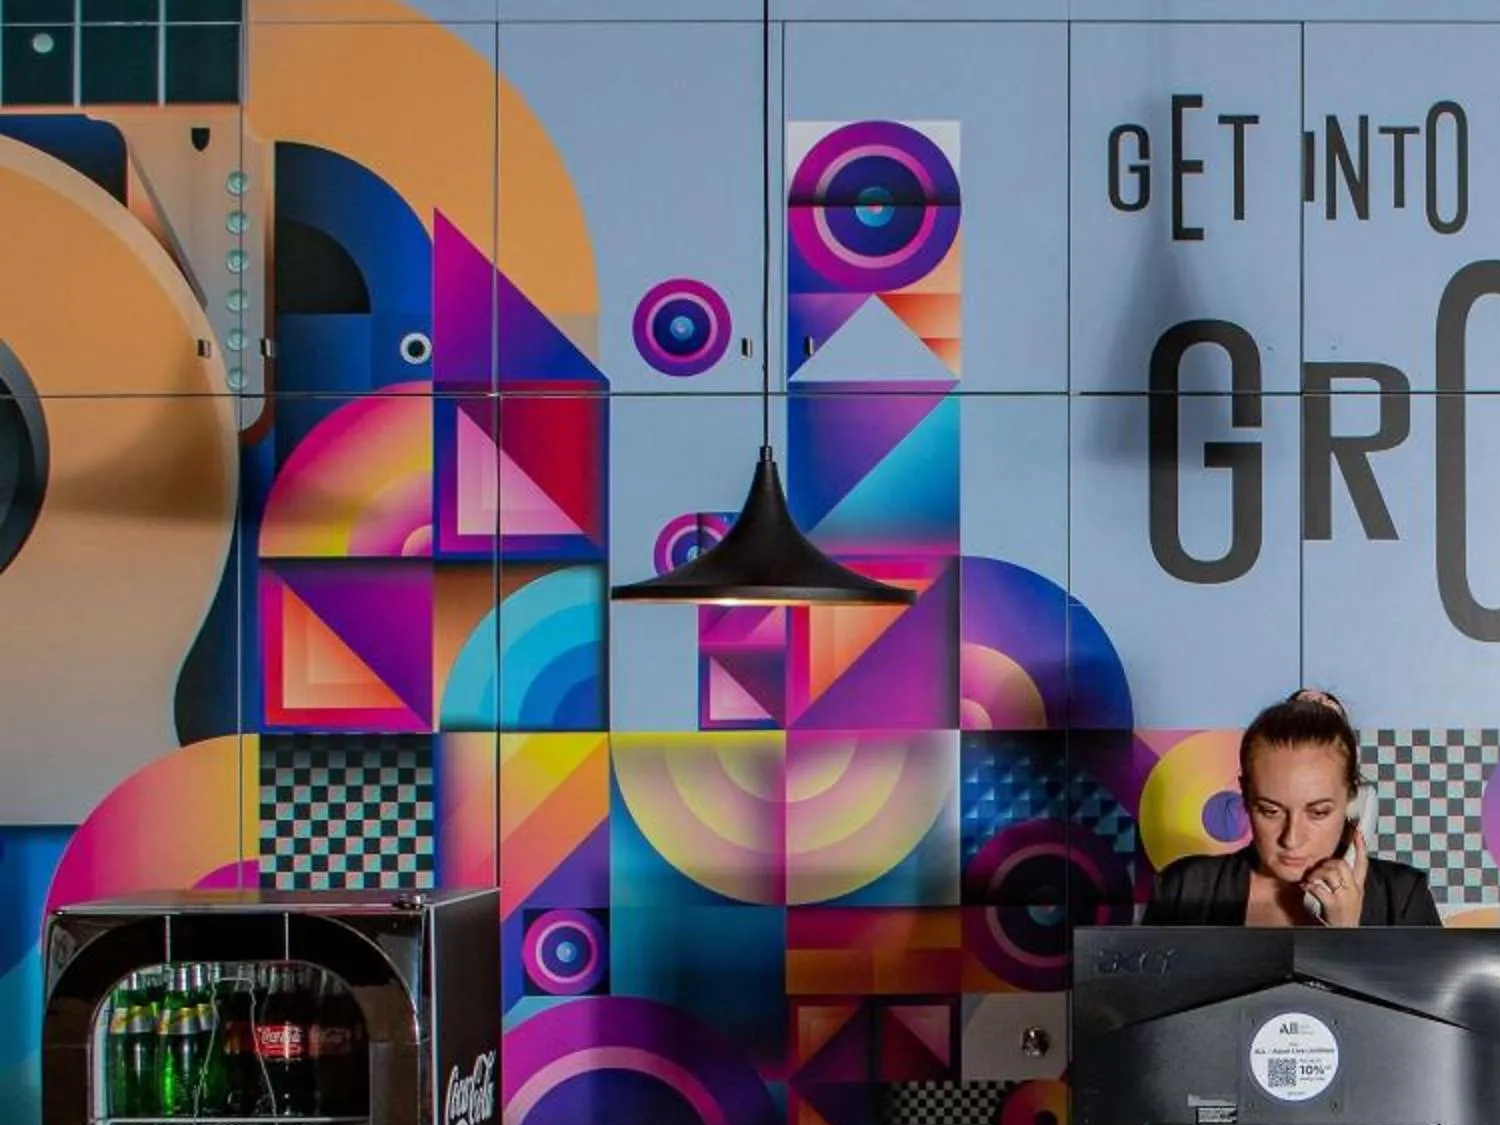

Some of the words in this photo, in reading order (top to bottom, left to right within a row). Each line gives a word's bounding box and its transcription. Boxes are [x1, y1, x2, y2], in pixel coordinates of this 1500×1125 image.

[1107, 94, 1260, 241] GET
[1303, 100, 1468, 235] INTO
[1300, 1065, 1325, 1076] 10%
